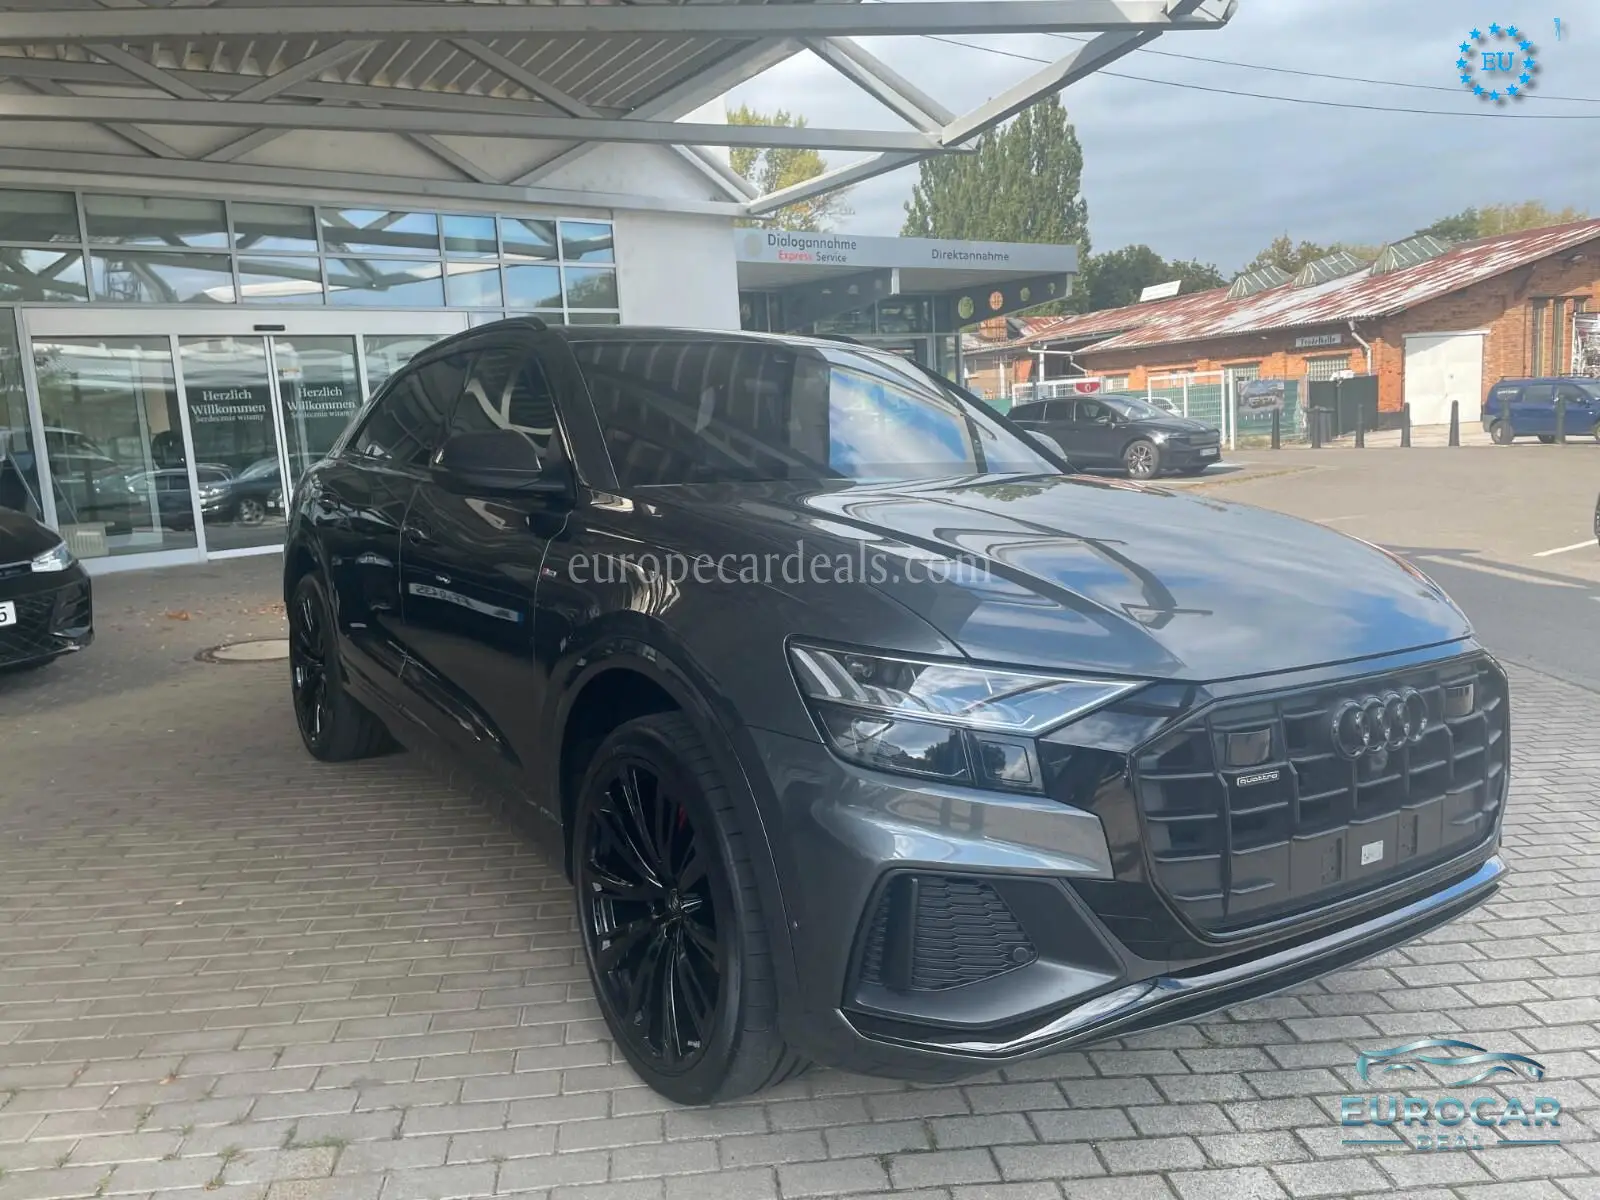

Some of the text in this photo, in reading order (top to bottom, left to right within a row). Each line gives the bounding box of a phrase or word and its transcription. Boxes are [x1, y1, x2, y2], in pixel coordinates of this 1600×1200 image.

[767, 233, 857, 250] Dialogannahme
[778, 249, 848, 263] Express Service
[931, 248, 1010, 261] Direktannahme
[202, 389, 252, 401] Herzlich
[298, 386, 343, 398] Herzlich
[190, 403, 266, 416] Willkommen
[286, 399, 356, 411] Willkommen
[1239, 772, 1279, 785] quattro
